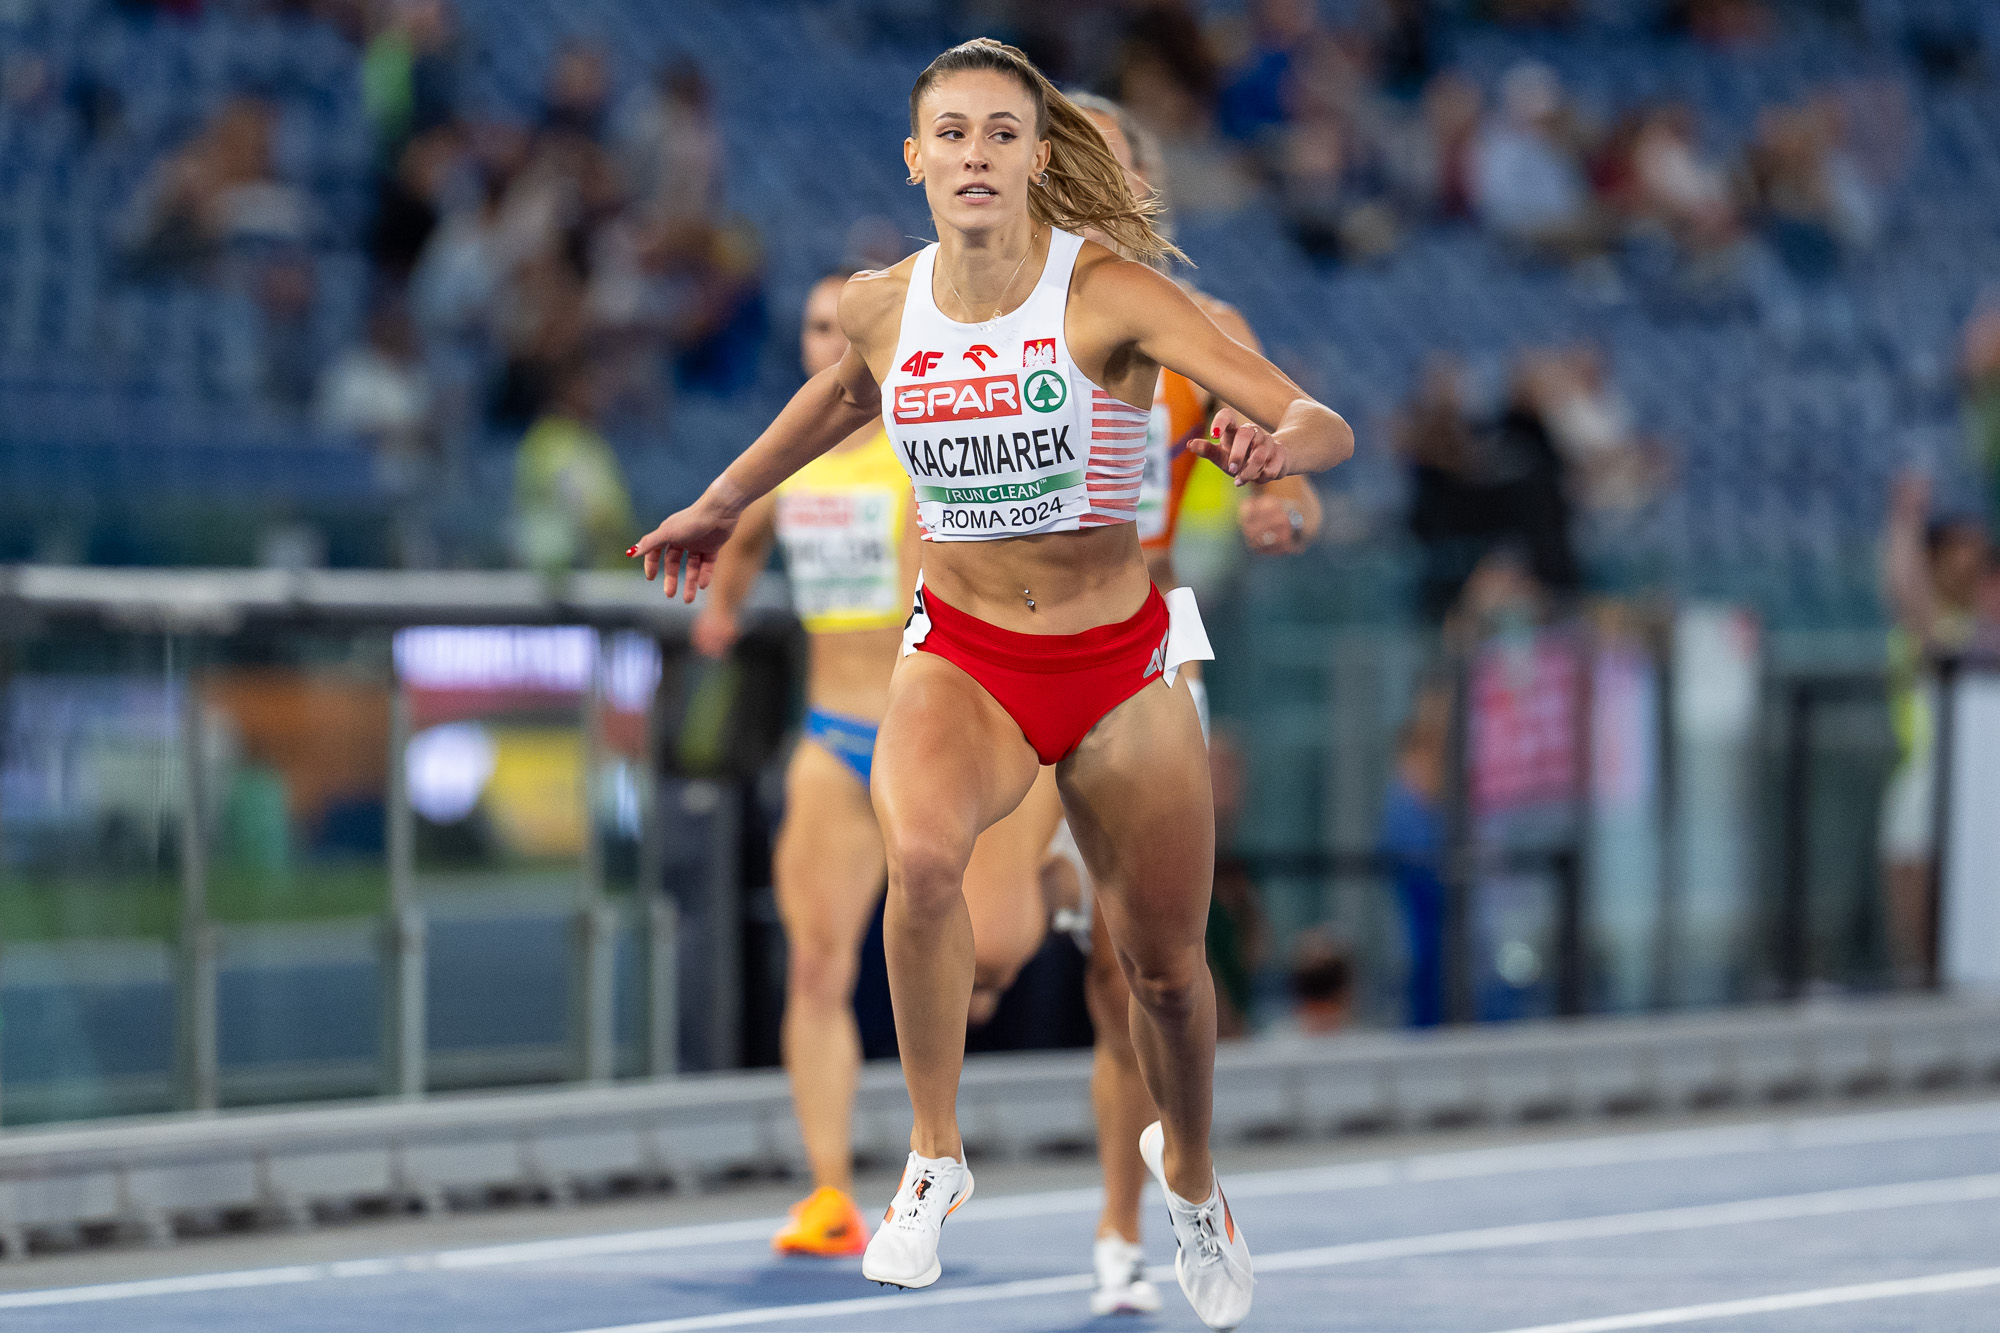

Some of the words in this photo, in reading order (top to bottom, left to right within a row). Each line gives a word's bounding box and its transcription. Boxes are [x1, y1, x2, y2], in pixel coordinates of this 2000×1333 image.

[901, 350, 944, 377] 4F
[896, 380, 1018, 419] SPAR
[903, 424, 1076, 478] KACZMAREK
[945, 489, 951, 502] I
[952, 488, 985, 502] RUN
[942, 509, 1007, 529] ROMA
[1009, 496, 1064, 526] 2024
